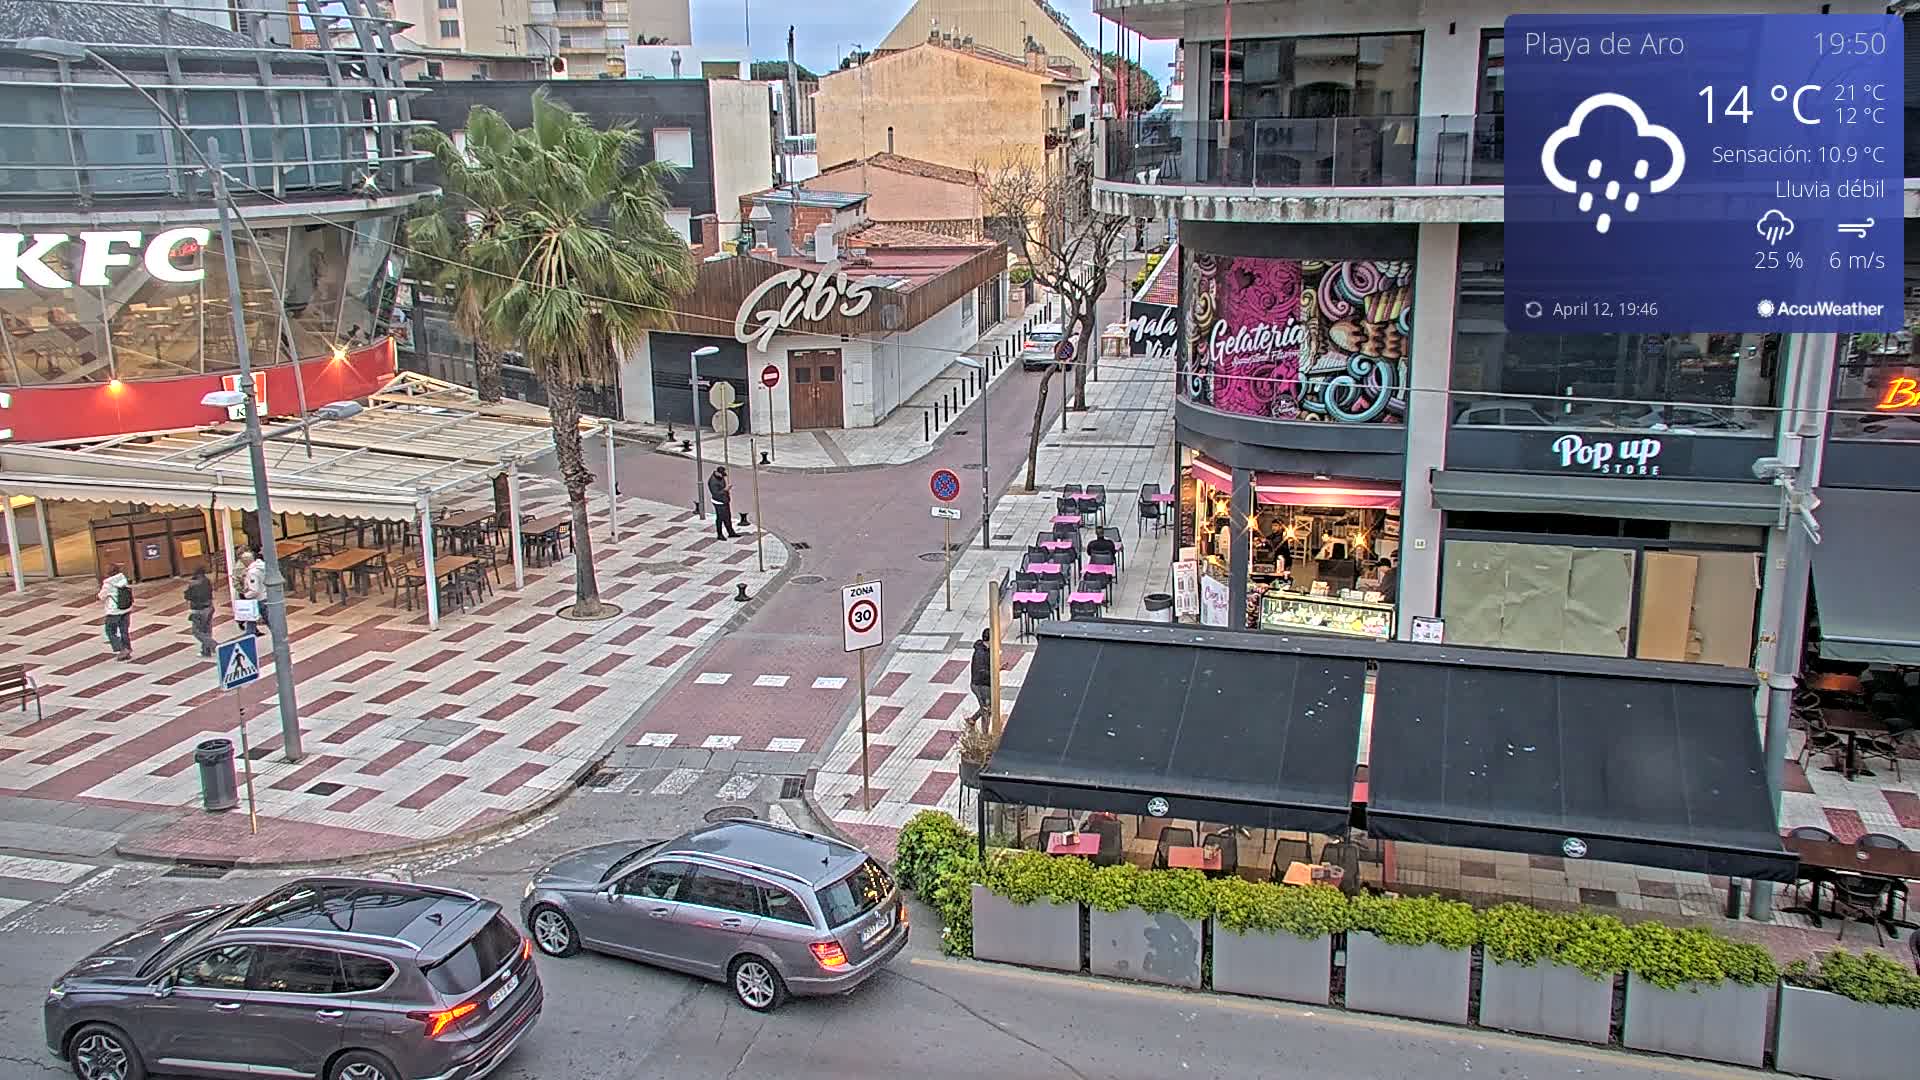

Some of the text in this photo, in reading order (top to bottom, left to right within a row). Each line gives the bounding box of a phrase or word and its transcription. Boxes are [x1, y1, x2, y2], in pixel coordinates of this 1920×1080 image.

[0, 227, 211, 289] KFC
[735, 259, 876, 352] Gib's
[1210, 318, 1309, 366] Gelateria
[1552, 434, 1661, 470] Pop up
[1602, 464, 1660, 475] STORE
[850, 586, 874, 597] ZONA
[855, 609, 872, 622] 30
